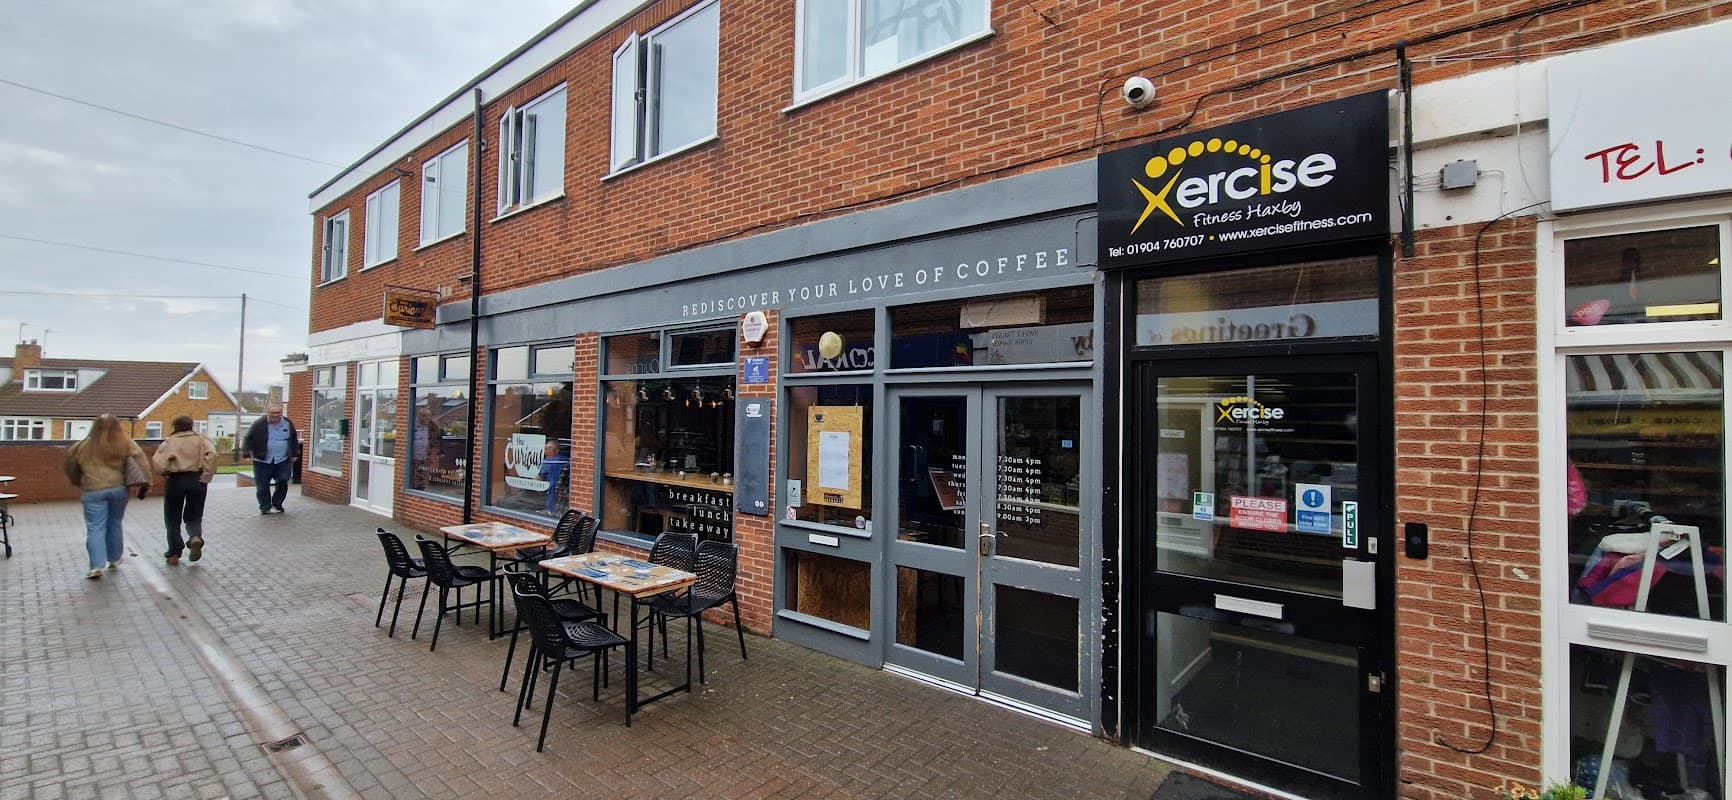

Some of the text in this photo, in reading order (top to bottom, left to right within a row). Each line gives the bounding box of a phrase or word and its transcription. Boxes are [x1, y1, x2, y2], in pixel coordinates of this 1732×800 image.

[1584, 140, 1704, 183] TEL:
[1130, 153, 1337, 235] Xercise
[1193, 200, 1302, 228] Fitness Haxby
[1108, 211, 1372, 258] Tel: 01904 760707 www.xercisefitness.com
[682, 248, 1069, 317] REDISCOVER YOUR LOVE OF COFFEE
[1216, 404, 1284, 424] Xercise
[1025, 457, 1041, 465] 4pm
[1025, 467, 1041, 475] 4pm
[1025, 477, 1041, 485] 4pm
[1025, 486, 1041, 494] 4pm
[669, 488, 730, 507] breakfast
[1235, 498, 1283, 511] PLEASE
[693, 506, 729, 521] lunch
[1346, 513, 1355, 544] PULL
